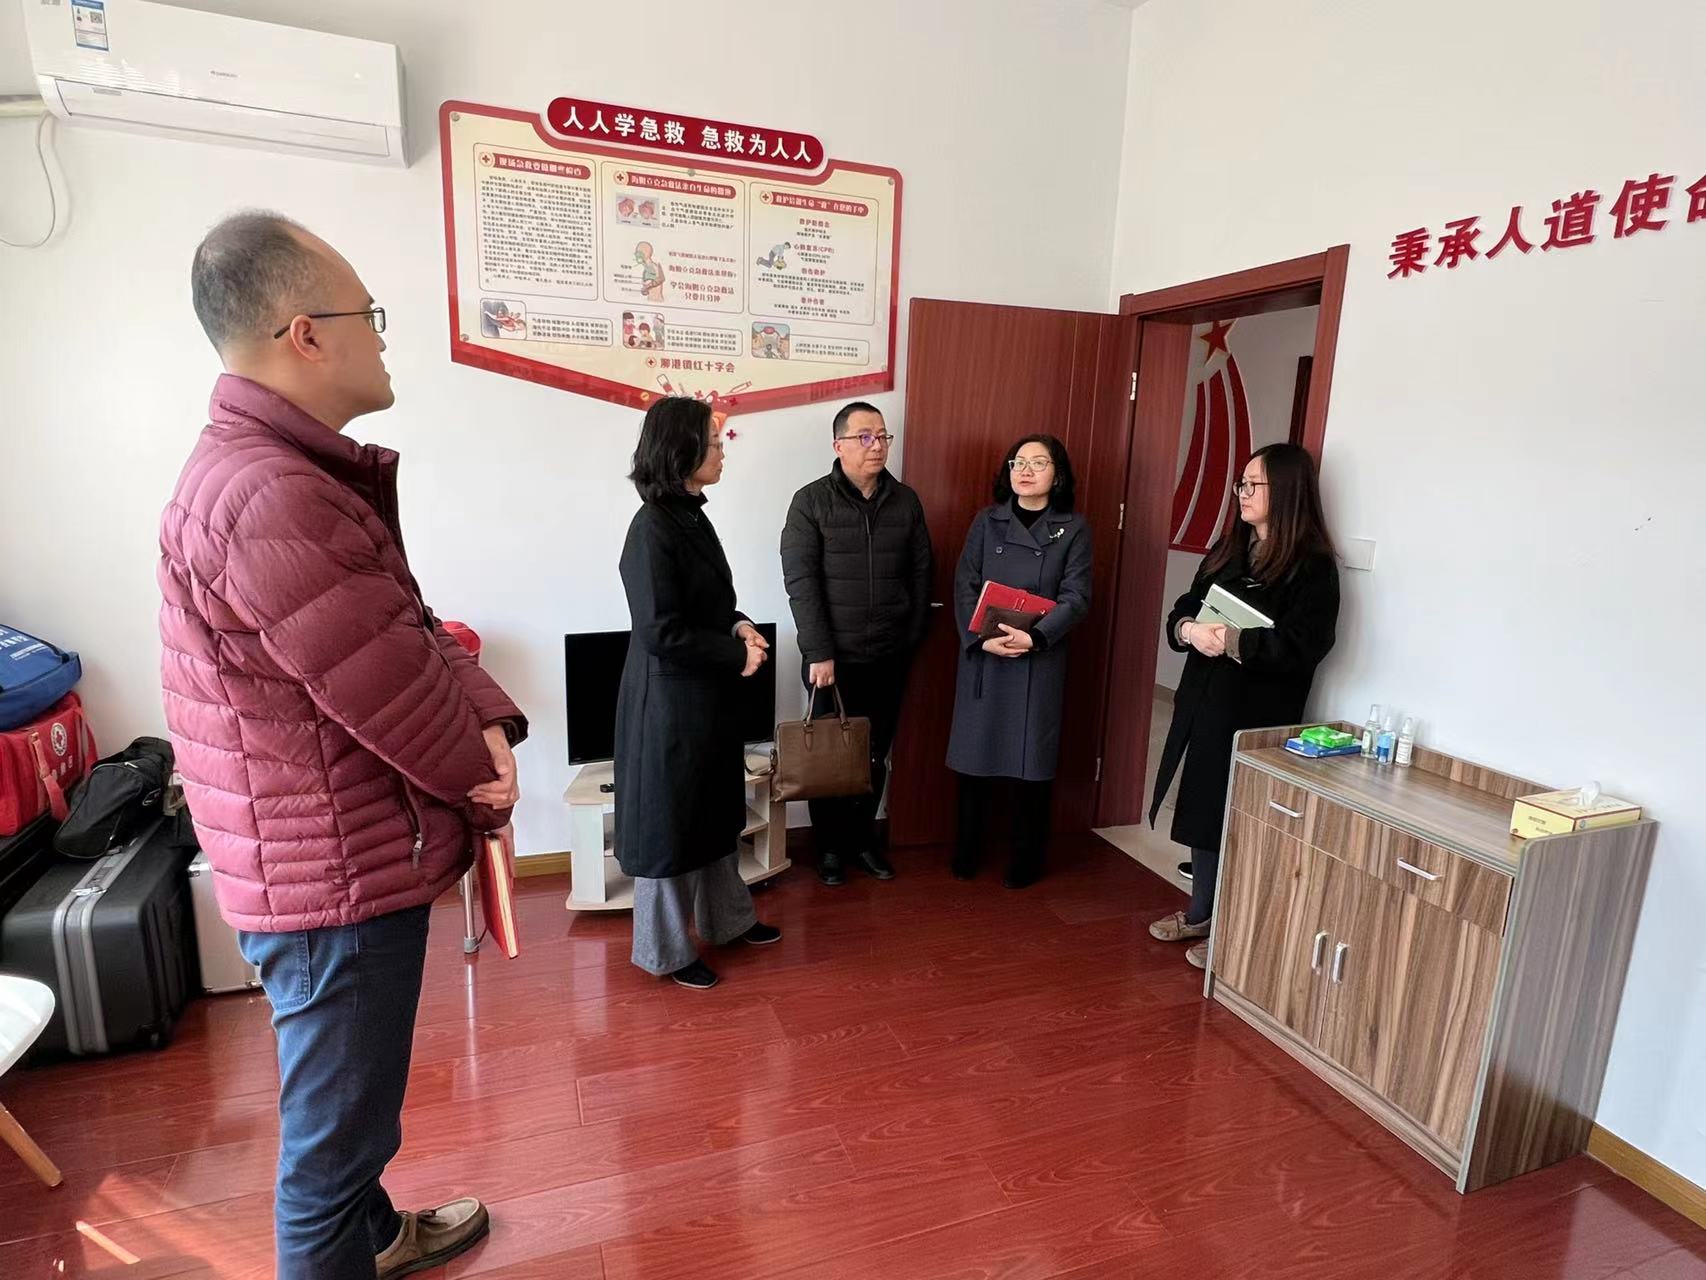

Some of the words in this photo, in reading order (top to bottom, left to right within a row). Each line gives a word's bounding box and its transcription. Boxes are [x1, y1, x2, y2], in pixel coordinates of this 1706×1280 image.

[563, 106, 685, 146] 人人学急救
[701, 126, 813, 163] 急救为人人
